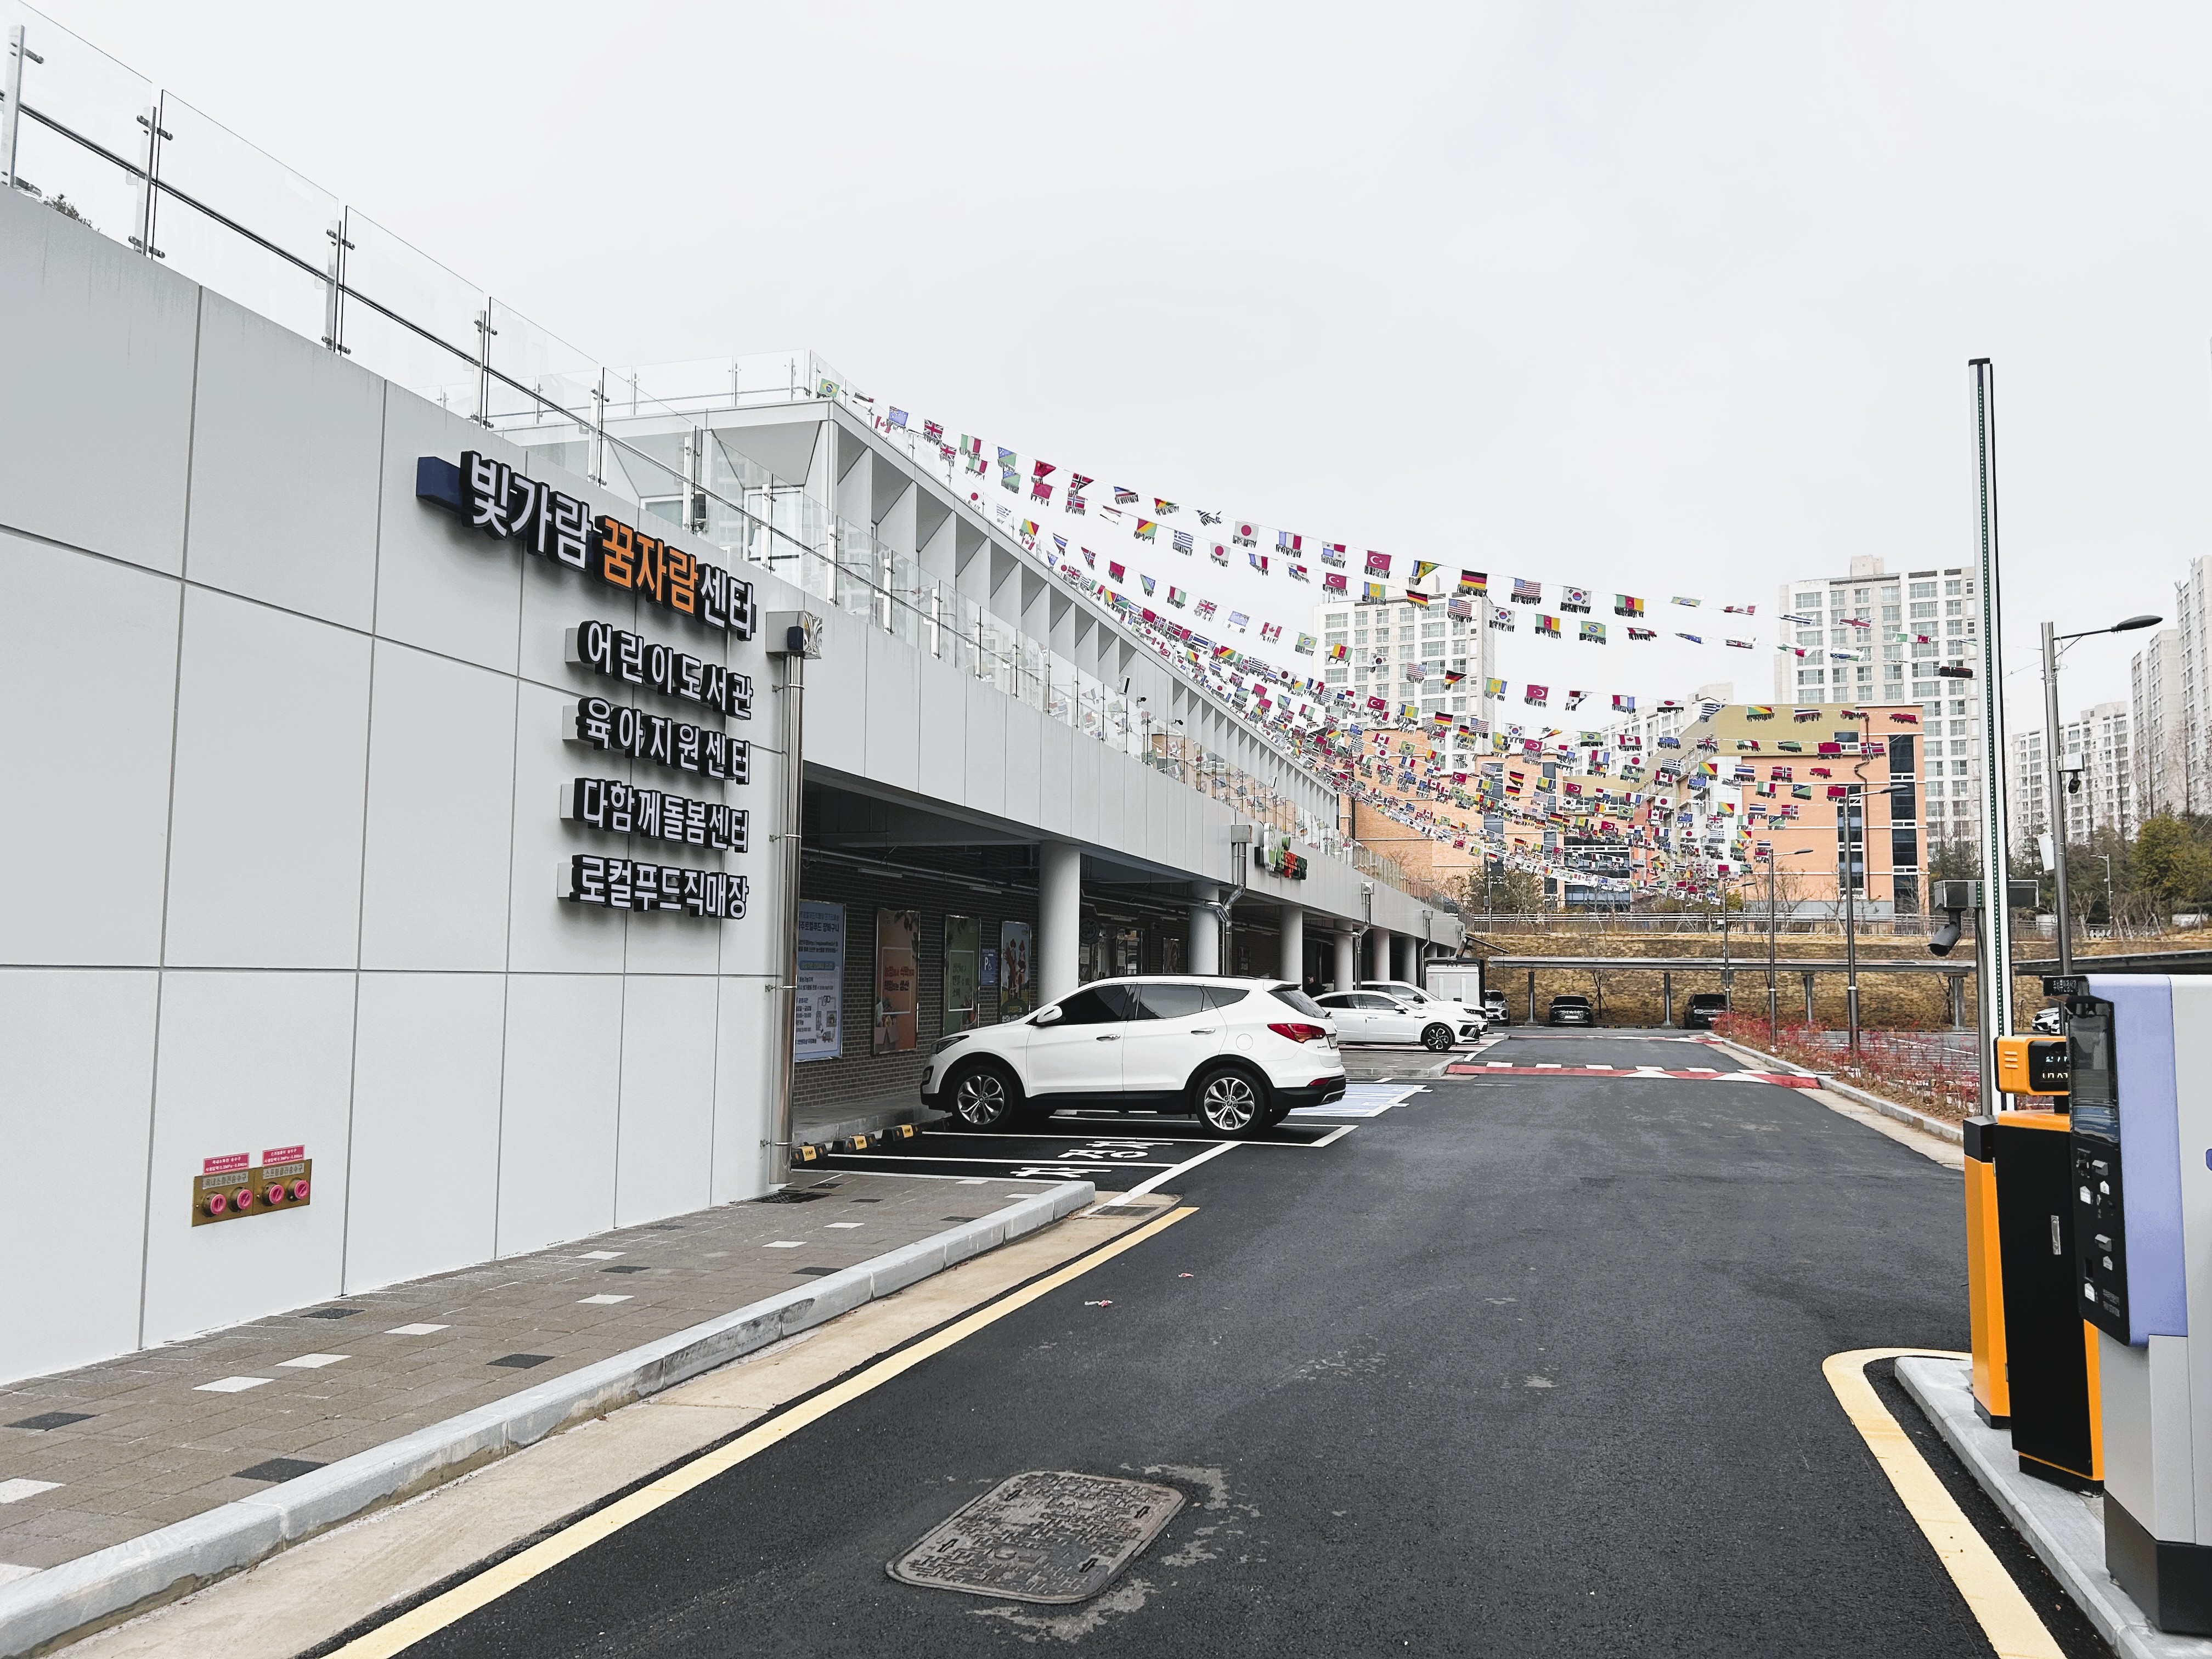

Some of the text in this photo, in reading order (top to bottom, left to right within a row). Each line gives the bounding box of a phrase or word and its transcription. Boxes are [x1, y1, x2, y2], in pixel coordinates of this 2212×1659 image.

[471, 453, 592, 570] 빛가람
[588, 622, 752, 720] 어린이도서관
[585, 698, 750, 785] 육아지원센터
[583, 780, 749, 852] 다함께돌봄센터
[579, 856, 749, 918] 로컬푸드직매장
